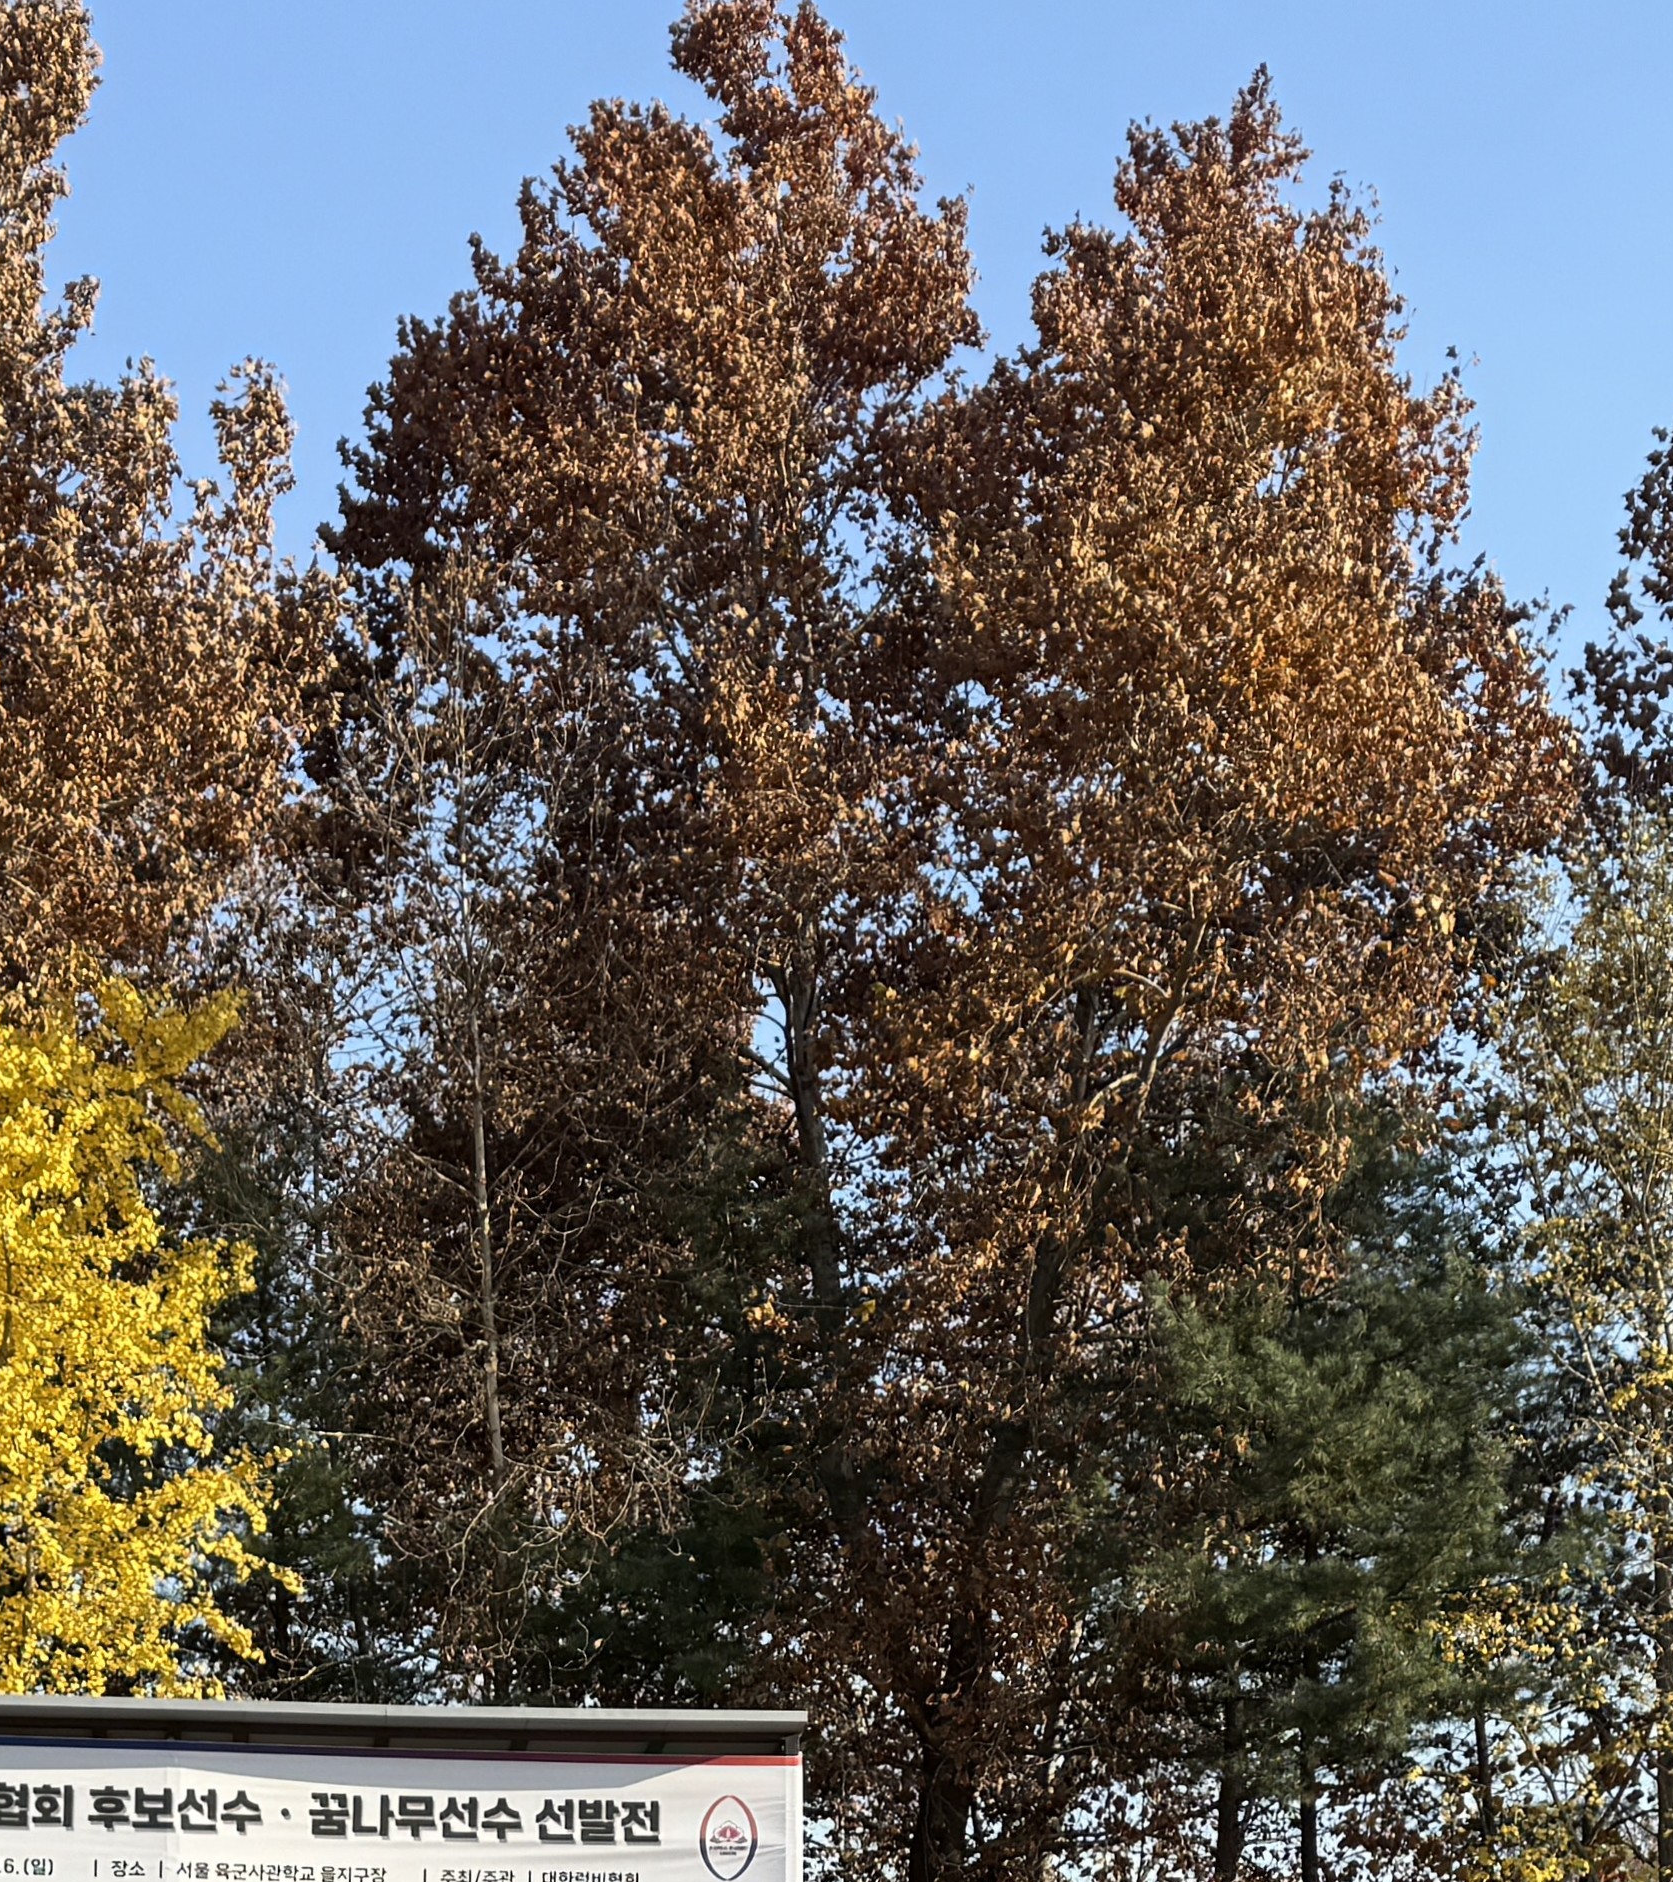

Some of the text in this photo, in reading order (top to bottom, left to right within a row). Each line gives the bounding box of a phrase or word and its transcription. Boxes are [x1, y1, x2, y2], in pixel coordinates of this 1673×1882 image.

[87, 1785, 263, 1835] 후보선수
[308, 1791, 524, 1843] 꿈나무선수
[535, 1798, 662, 1845] 선발전
[111, 1860, 146, 1878] 장소
[176, 1861, 209, 1880] 서울
